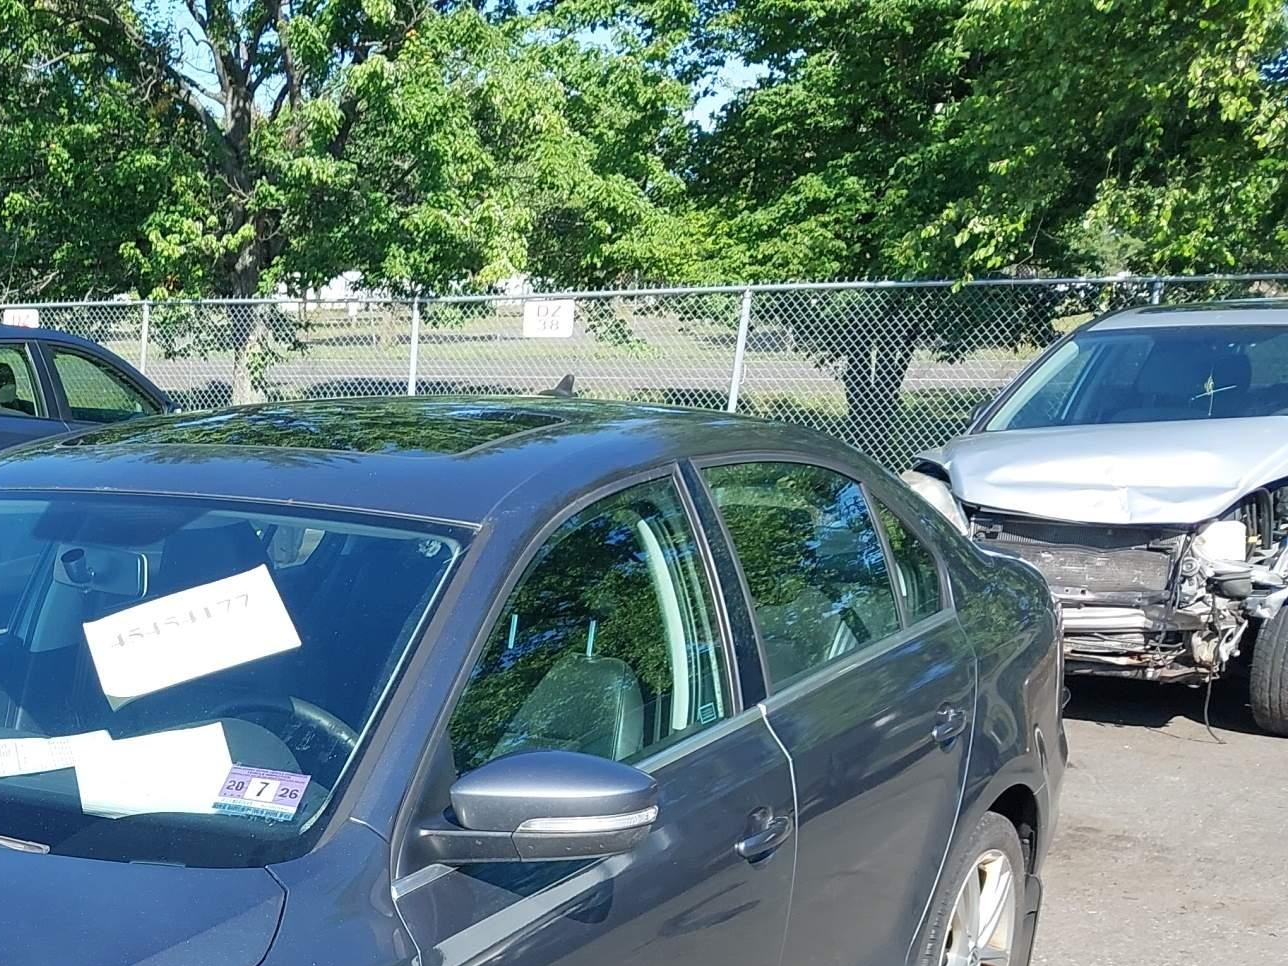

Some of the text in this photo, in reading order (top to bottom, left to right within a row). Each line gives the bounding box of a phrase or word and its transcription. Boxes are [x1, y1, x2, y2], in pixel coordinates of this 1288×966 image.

[226, 780, 300, 800] 20 7 26
